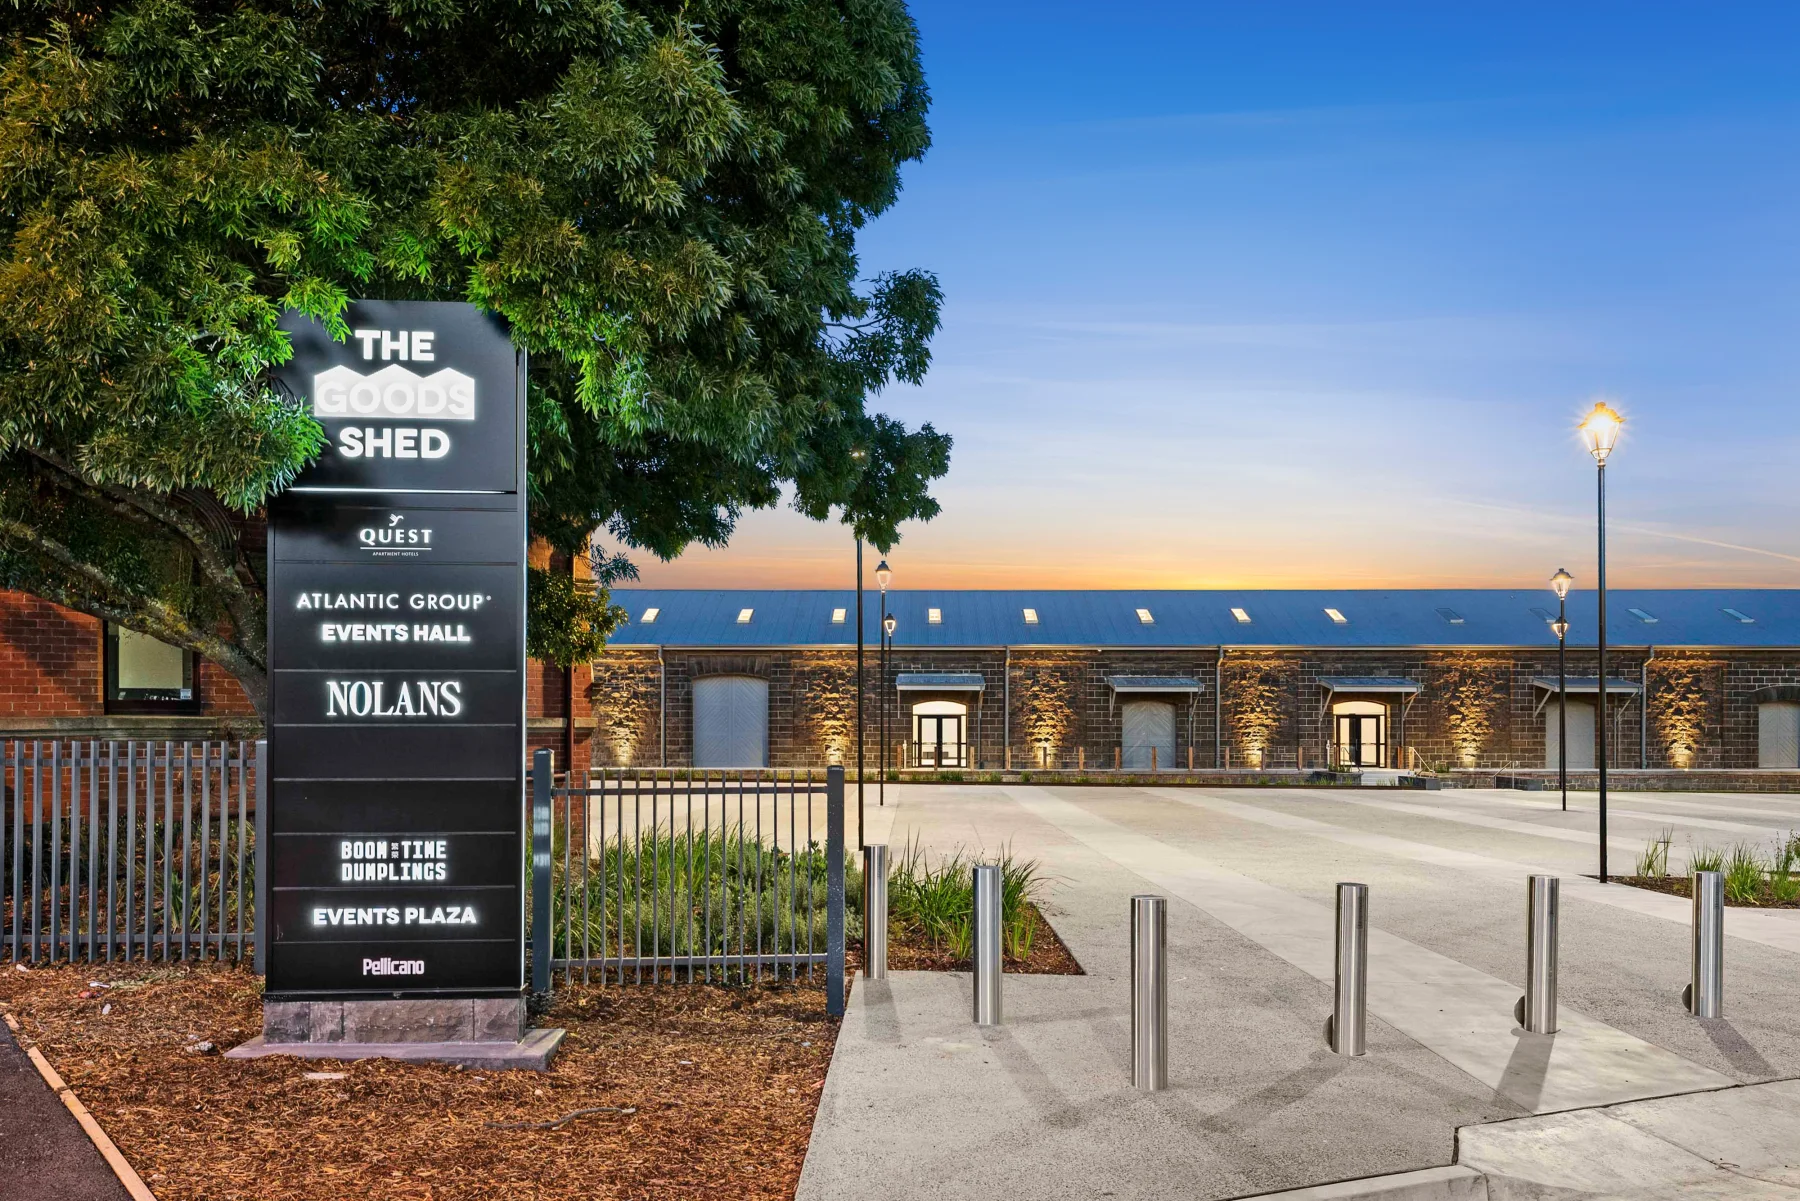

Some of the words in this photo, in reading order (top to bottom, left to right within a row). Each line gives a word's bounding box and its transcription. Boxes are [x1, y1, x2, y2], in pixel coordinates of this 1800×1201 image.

[355, 330, 434, 361] THE
[316, 382, 473, 415] GOODS
[338, 426, 450, 458] SHED
[359, 528, 432, 545] QUEST
[297, 592, 399, 609] ATLANTIC
[322, 624, 408, 641] EVENTS
[413, 625, 471, 642] HALL
[326, 681, 461, 716] NOLANS
[341, 841, 387, 859] BOOM
[401, 841, 447, 859] TIME
[341, 863, 447, 881] DUMPLINGS
[313, 908, 400, 926] EVENTS
[405, 907, 477, 925] PLAZA
[362, 957, 425, 976] Pellicano
